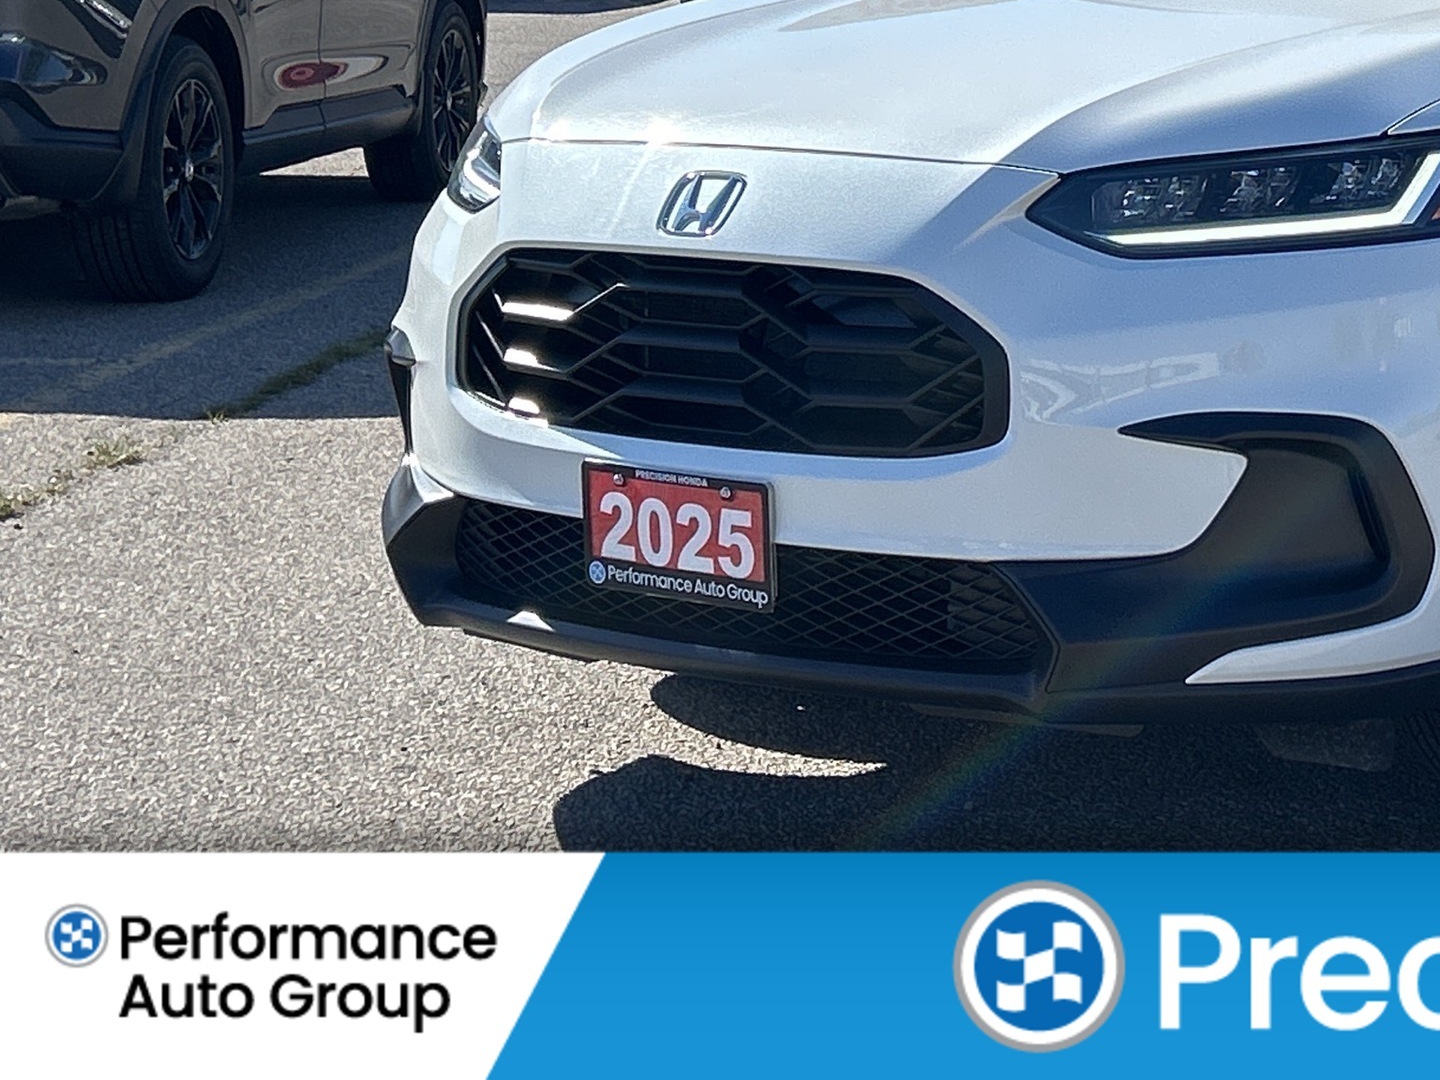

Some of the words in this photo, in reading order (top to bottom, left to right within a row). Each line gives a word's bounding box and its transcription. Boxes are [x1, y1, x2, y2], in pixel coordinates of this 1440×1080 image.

[635, 470, 677, 484] PRECISION
[677, 474, 709, 488] HONDA
[599, 491, 755, 580] 2025
[607, 565, 693, 592] Performance
[694, 578, 726, 598] Auto
[727, 584, 769, 609] Group
